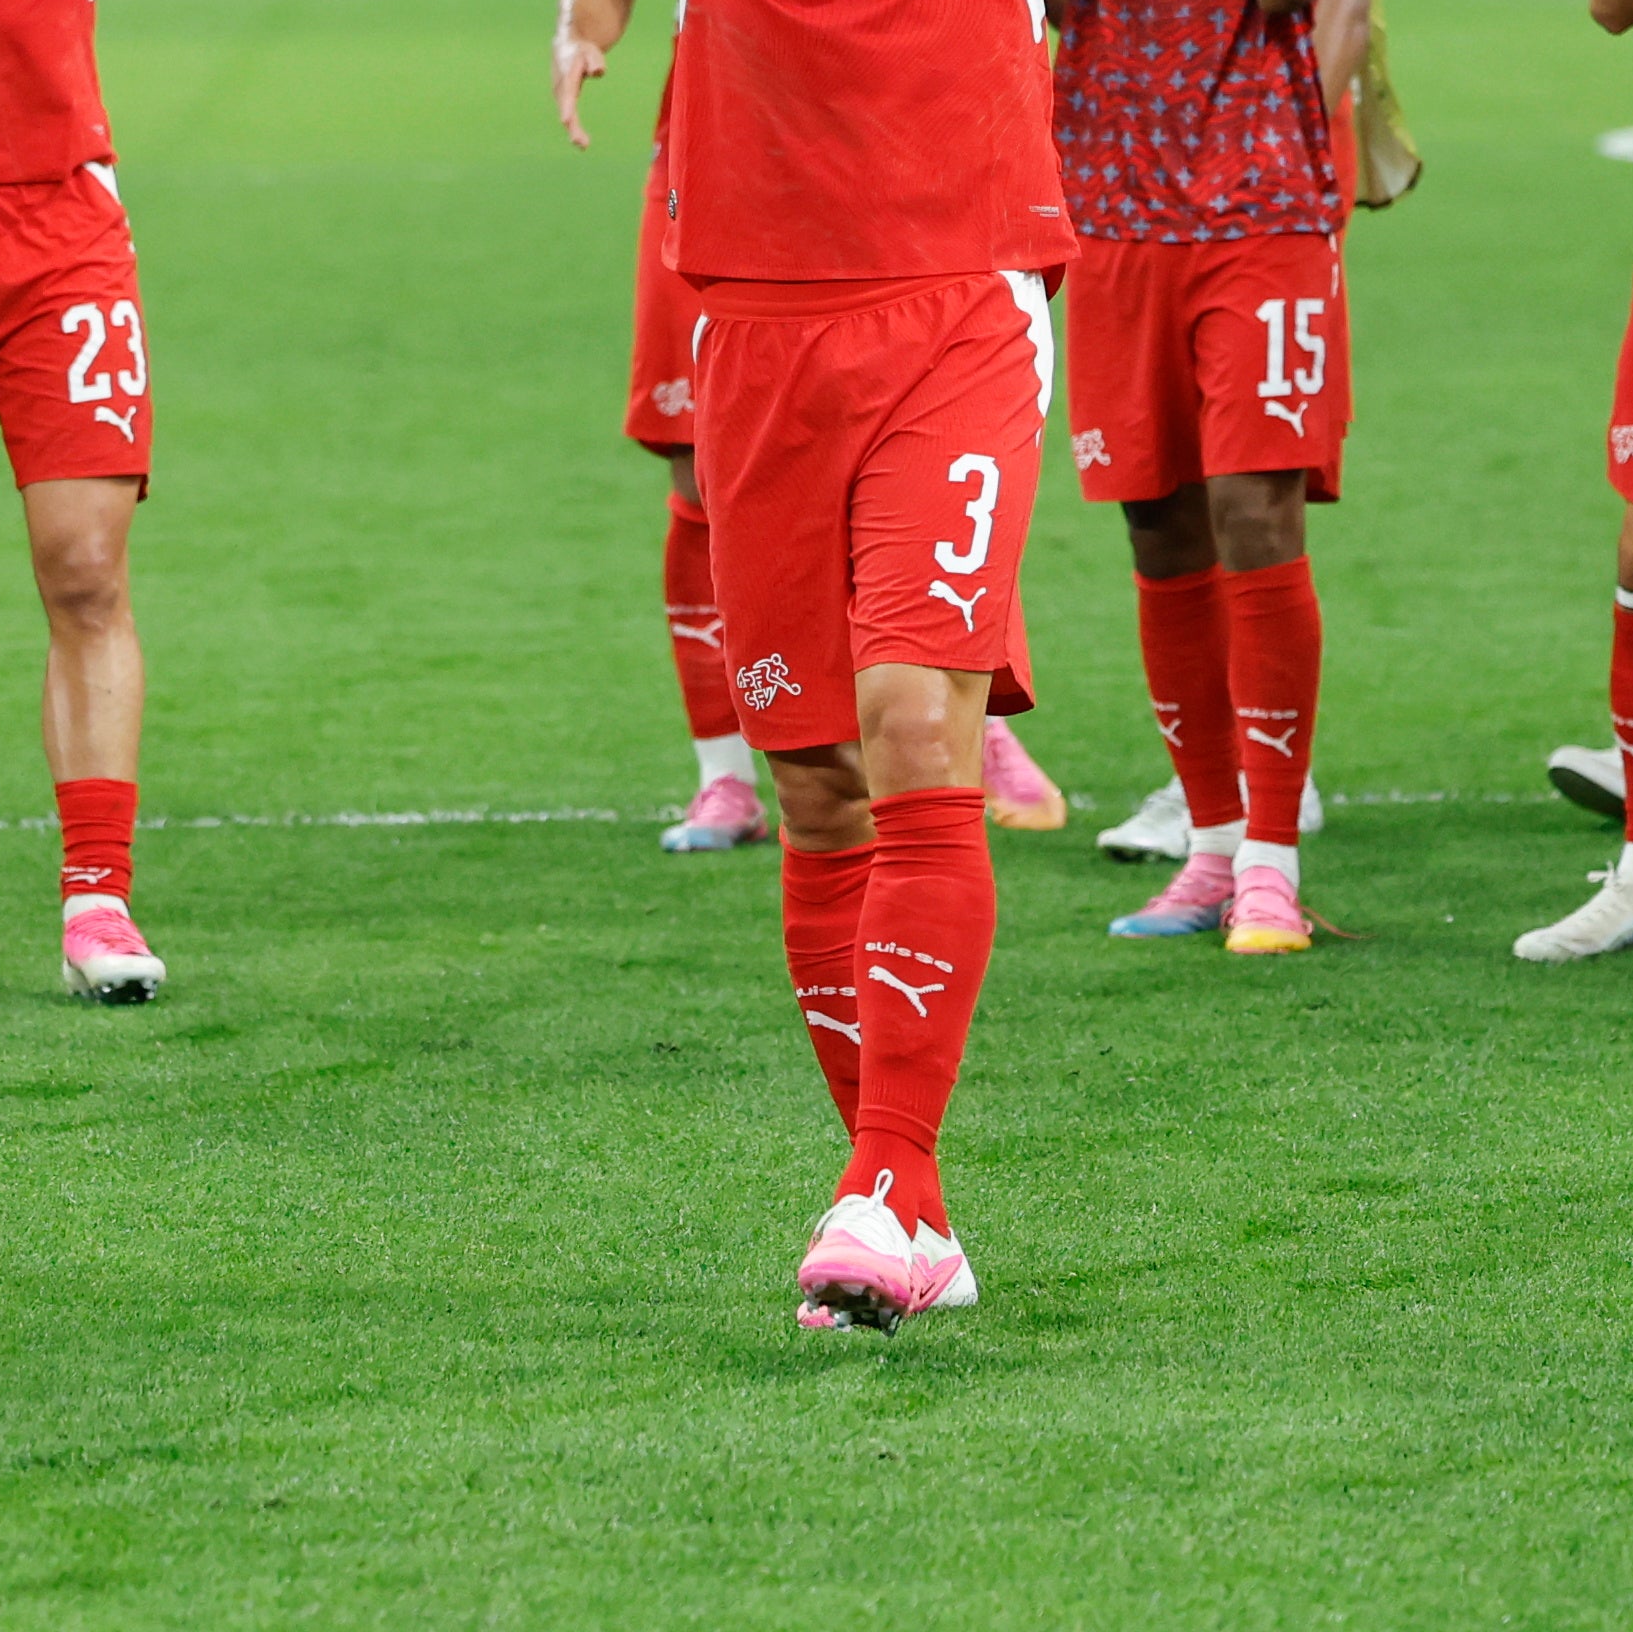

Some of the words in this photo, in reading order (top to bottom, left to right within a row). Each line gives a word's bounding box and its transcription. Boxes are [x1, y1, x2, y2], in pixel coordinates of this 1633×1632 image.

[61, 299, 147, 404] 23
[1256, 298, 1325, 396] 15
[934, 453, 1000, 575] 3
[795, 984, 857, 999] uiss
[864, 940, 954, 974] suisse
